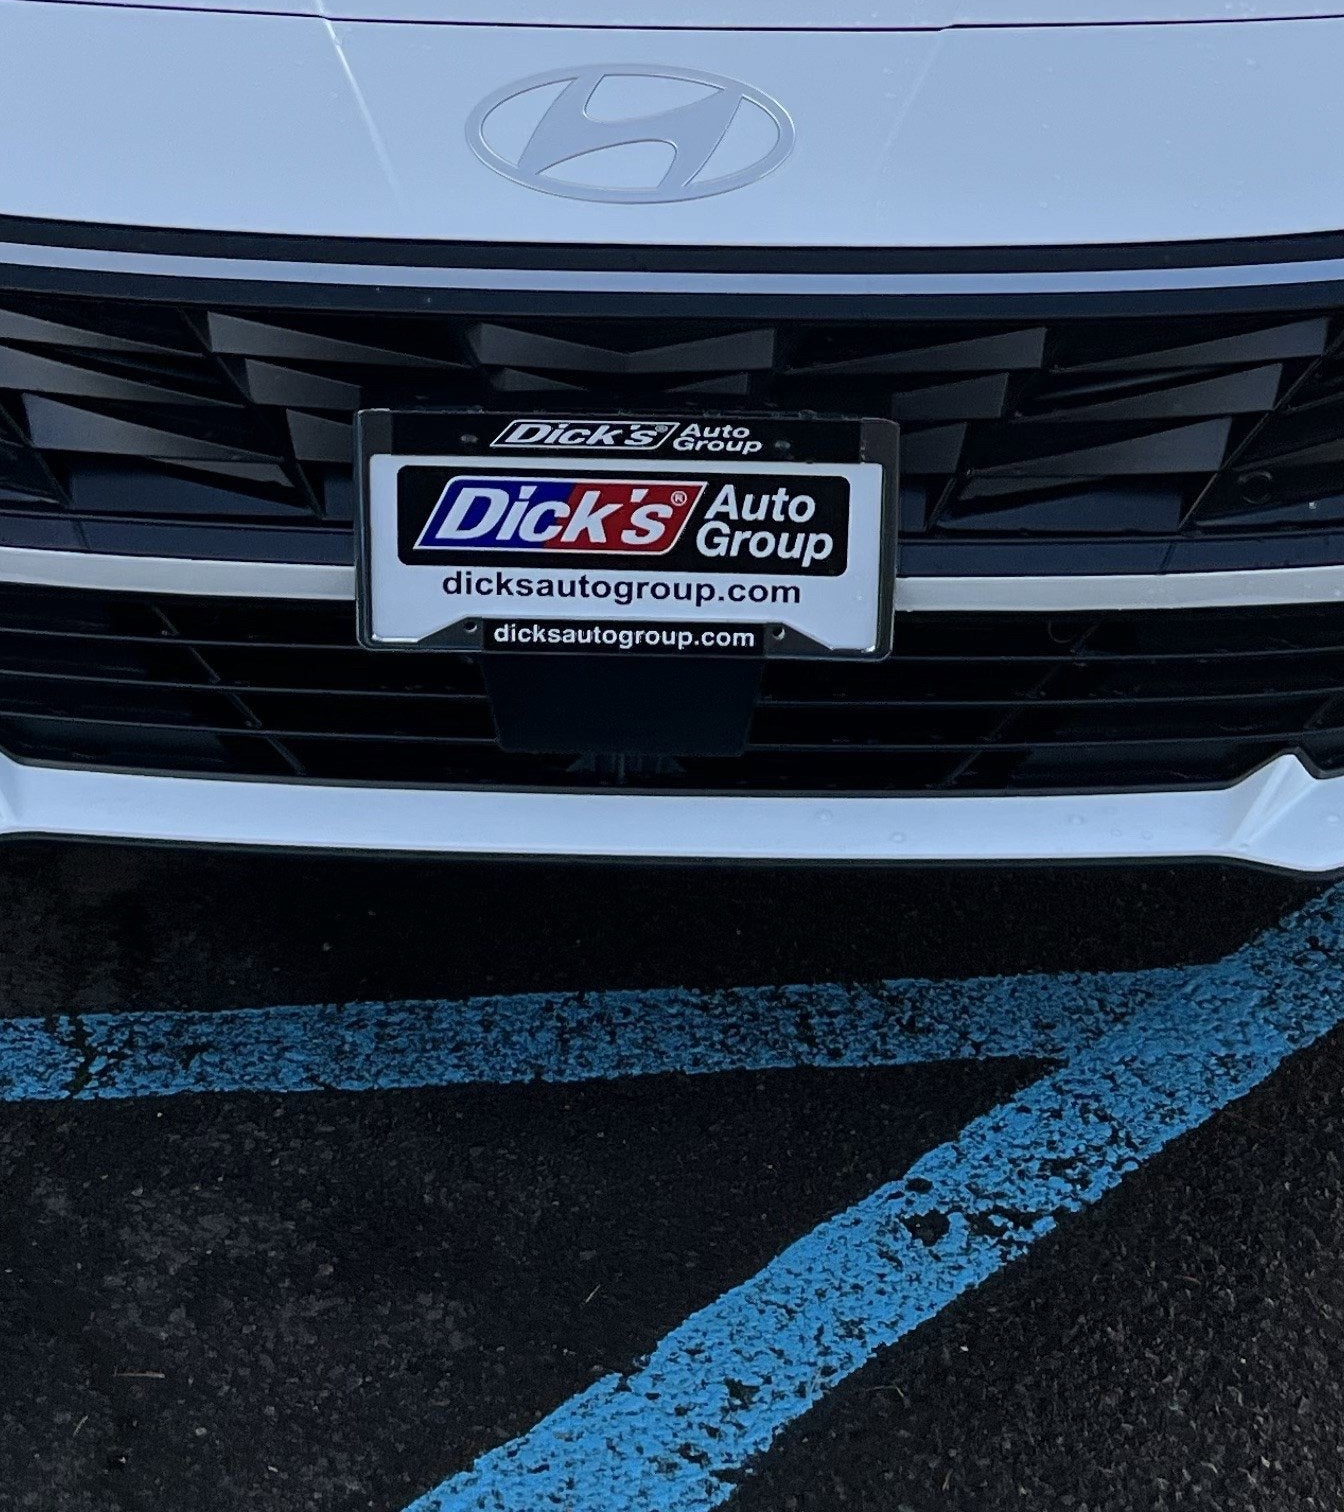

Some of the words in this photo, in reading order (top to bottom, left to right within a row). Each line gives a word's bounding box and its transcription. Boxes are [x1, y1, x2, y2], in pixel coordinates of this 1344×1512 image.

[672, 437, 763, 455] Group
[679, 423, 750, 439] Auto
[704, 484, 816, 523] Auto
[696, 520, 834, 567] Group
[442, 571, 801, 607] dicksautogroup.com
[493, 623, 755, 650] dicksautogroup.com
